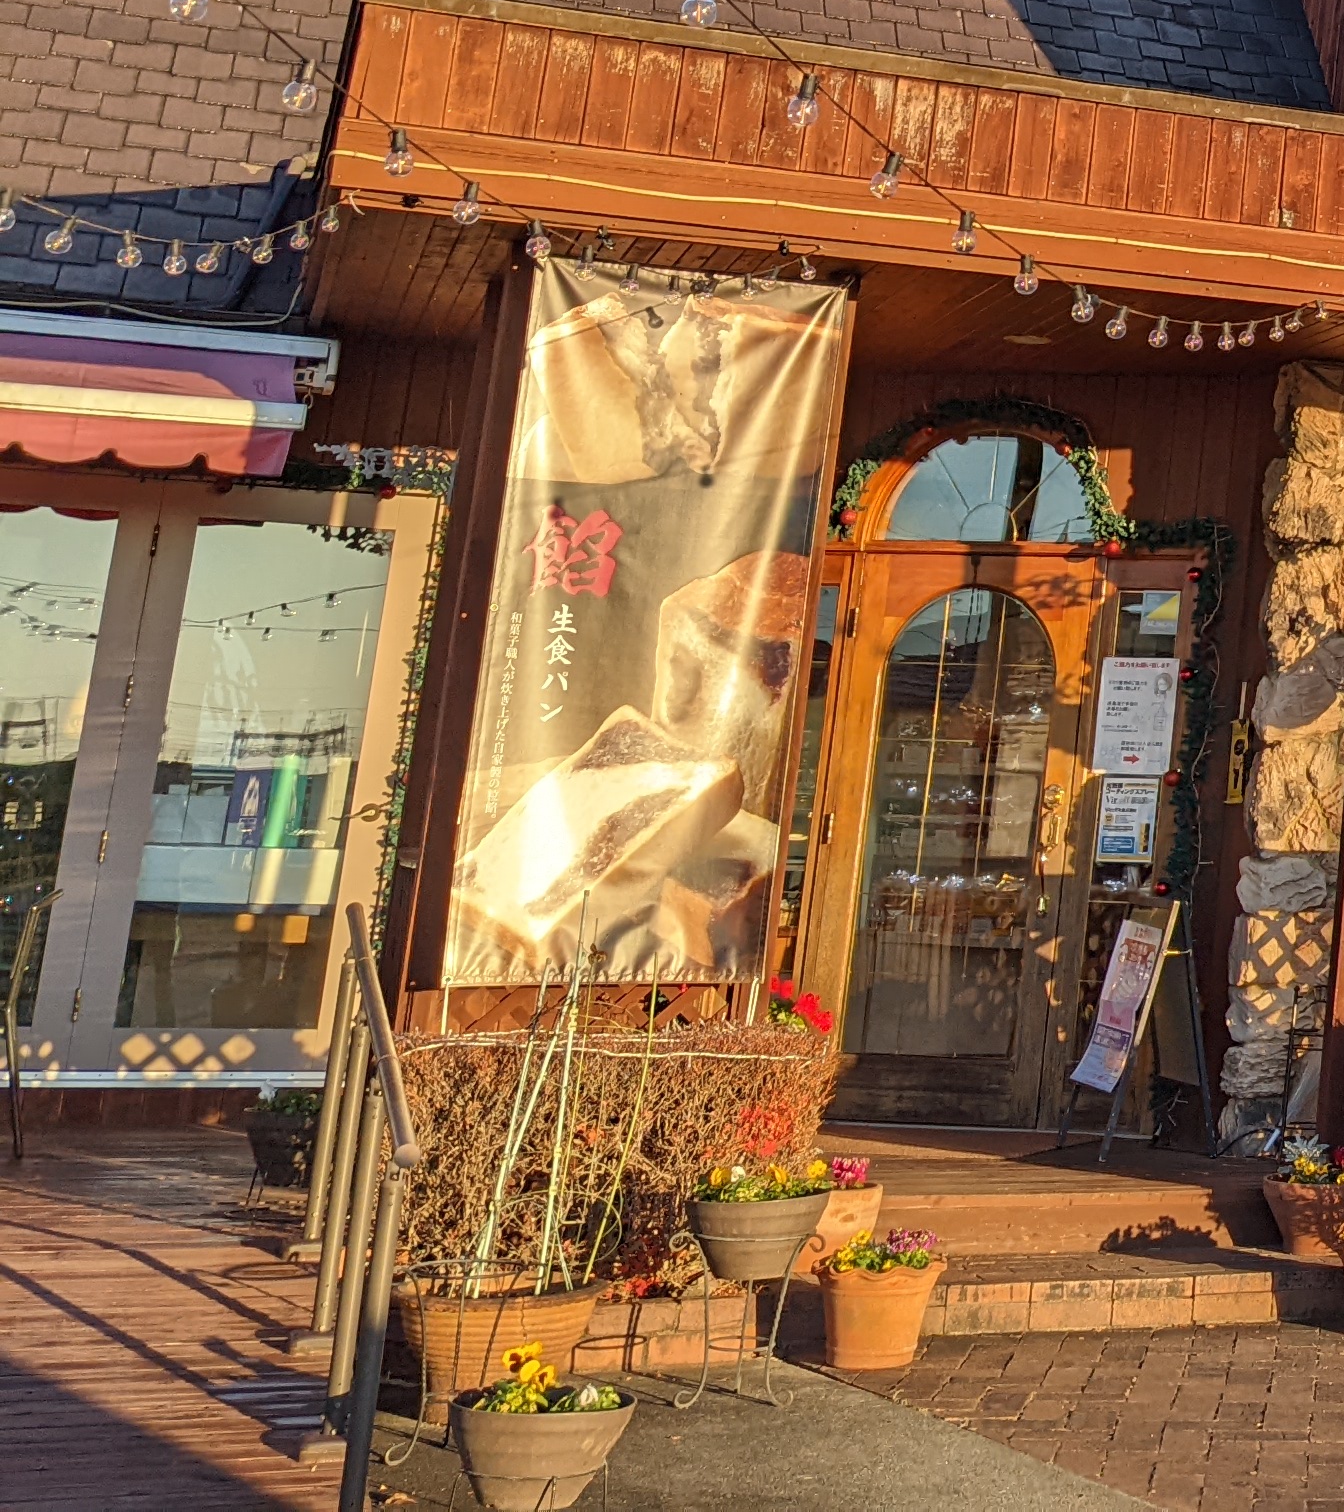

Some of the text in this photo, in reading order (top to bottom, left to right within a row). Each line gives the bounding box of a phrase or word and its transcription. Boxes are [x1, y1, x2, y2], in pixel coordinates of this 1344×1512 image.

[522, 504, 623, 597] 餡
[540, 604, 577, 722] 生食パン
